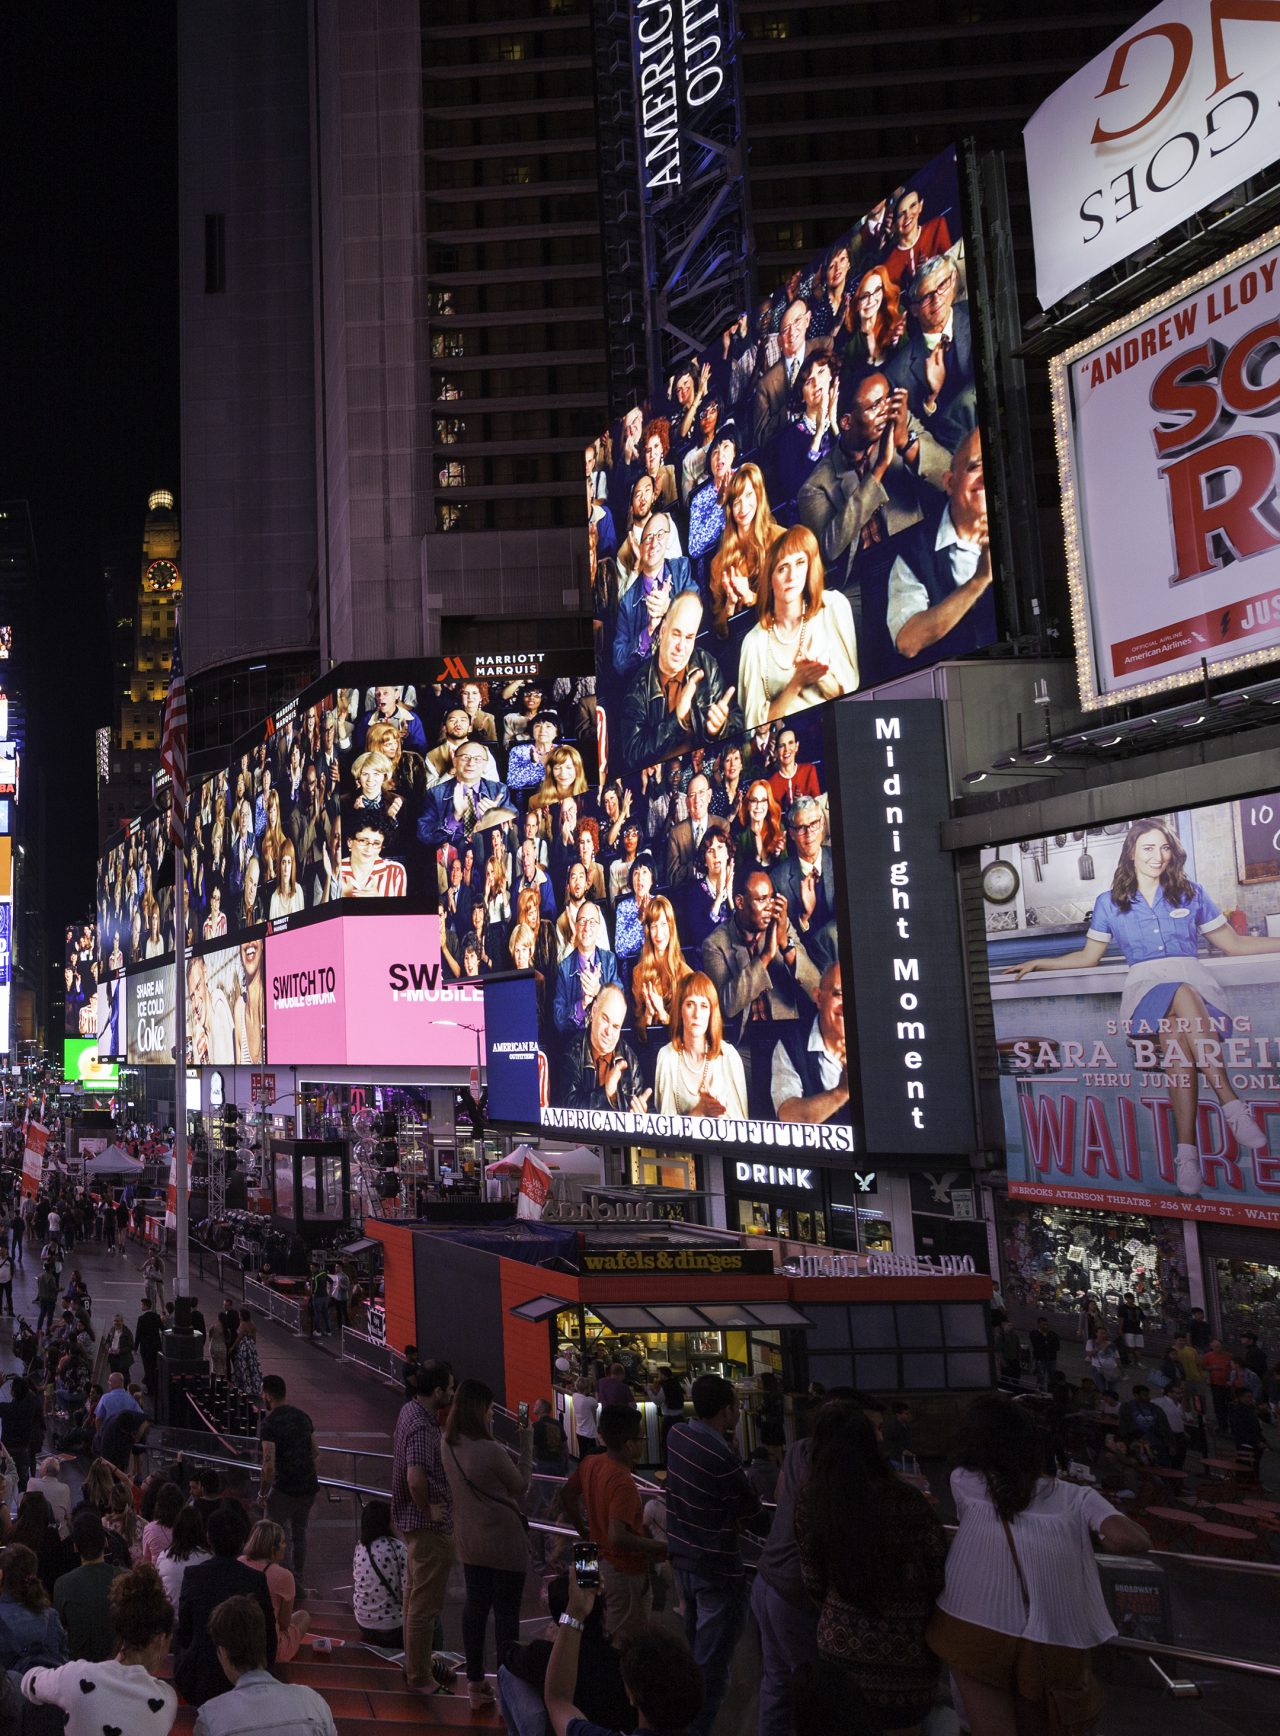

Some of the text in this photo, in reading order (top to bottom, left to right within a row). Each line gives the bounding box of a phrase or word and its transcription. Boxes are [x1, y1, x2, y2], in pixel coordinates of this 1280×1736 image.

[475, 653, 545, 665] MARRIOTT
[1124, 637, 1193, 664] American Airlines
[476, 665, 537, 676] MARQUIS
[875, 718, 925, 1129] Midnight Moment
[136, 980, 164, 999] SHARE AN
[273, 966, 336, 1001] SWITCH TO
[147, 998, 164, 1016] COLD
[1107, 1015, 1252, 1035] STARRING
[493, 1042, 528, 1052] AMERICAN
[1013, 1040, 1118, 1070] SARA
[1083, 1073, 1132, 1089] THRU
[1140, 1073, 1192, 1089] JUNE
[1201, 1073, 1224, 1089] 11
[541, 1107, 854, 1151] AMERICAN EAGLE OUTFITTERS
[736, 1161, 813, 1189] DRINK
[1018, 1187, 1053, 1198] BROOKS
[1056, 1190, 1105, 1203] ATKINSON
[1107, 1194, 1151, 1208] THEATRE
[1160, 1200, 1179, 1211] 256
